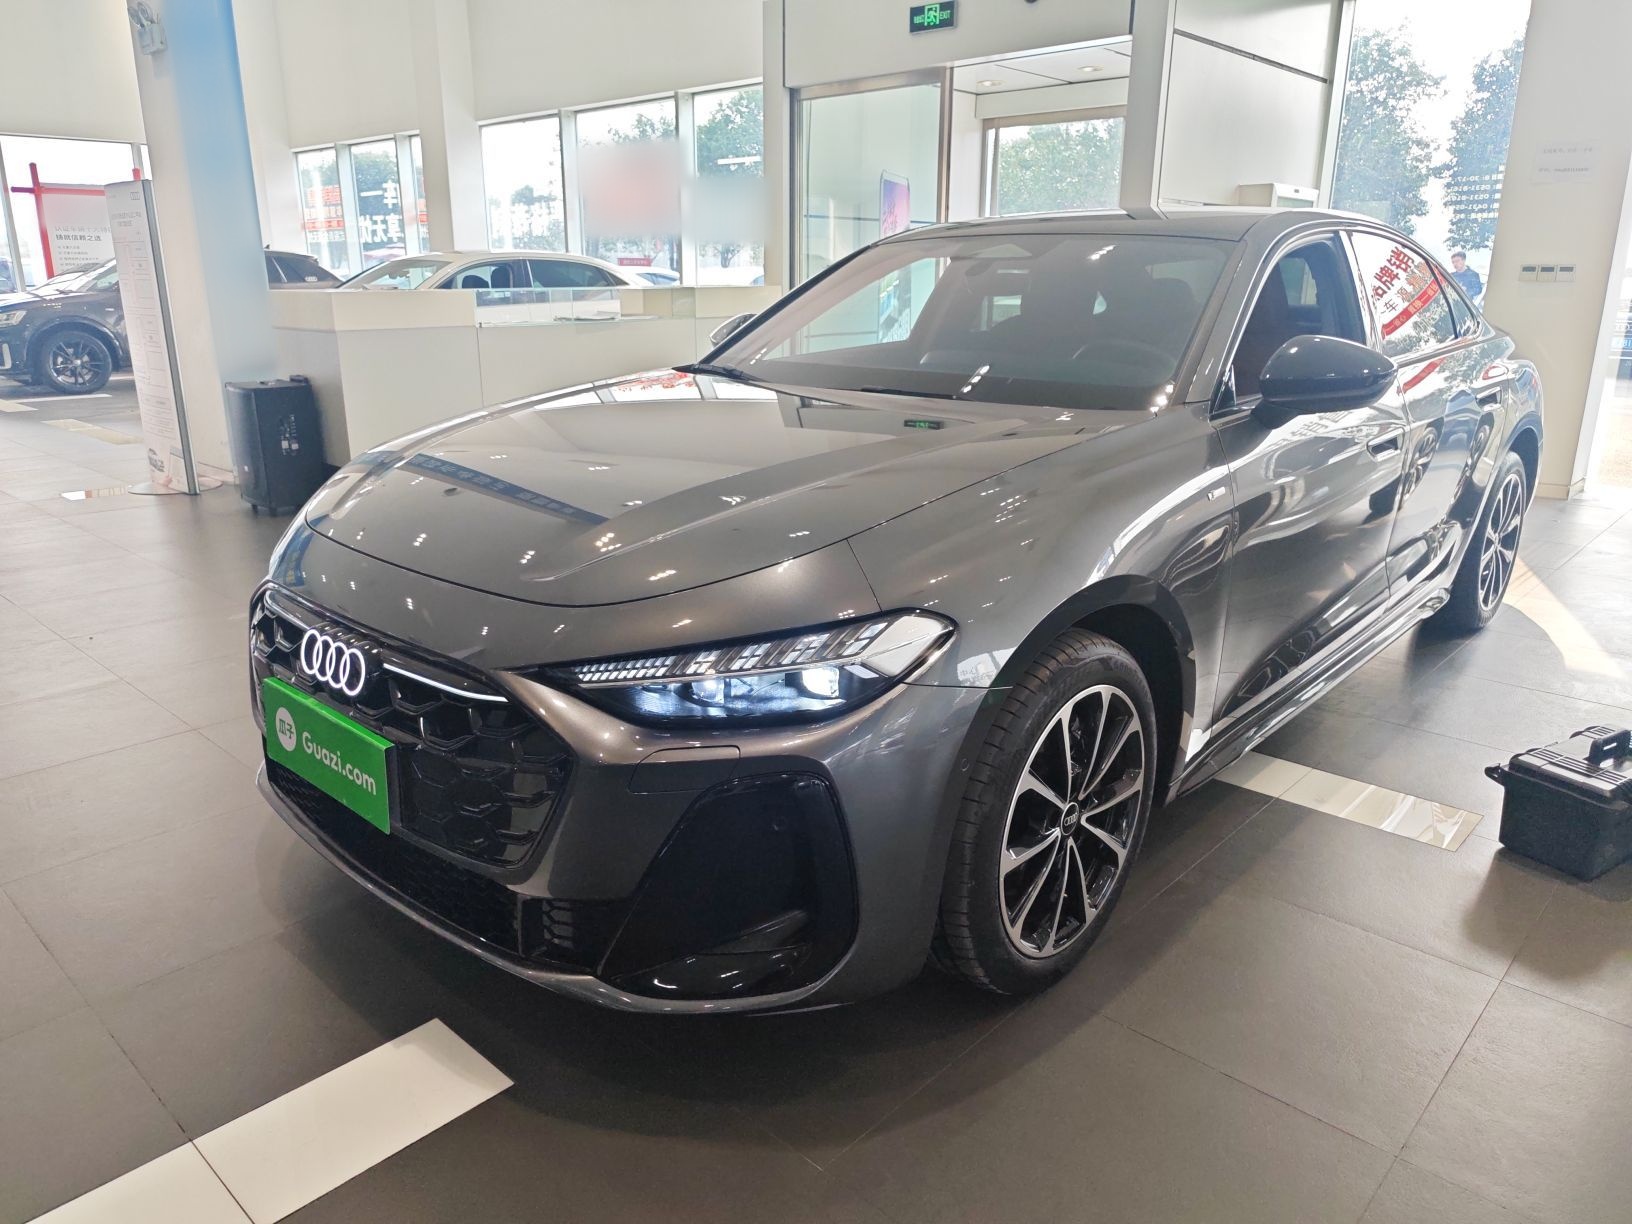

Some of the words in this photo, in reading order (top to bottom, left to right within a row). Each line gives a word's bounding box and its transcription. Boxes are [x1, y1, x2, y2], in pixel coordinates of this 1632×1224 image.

[939, 10, 951, 19] EXIT
[278, 718, 295, 739] 瓜子
[302, 730, 377, 796] Guazi.com
